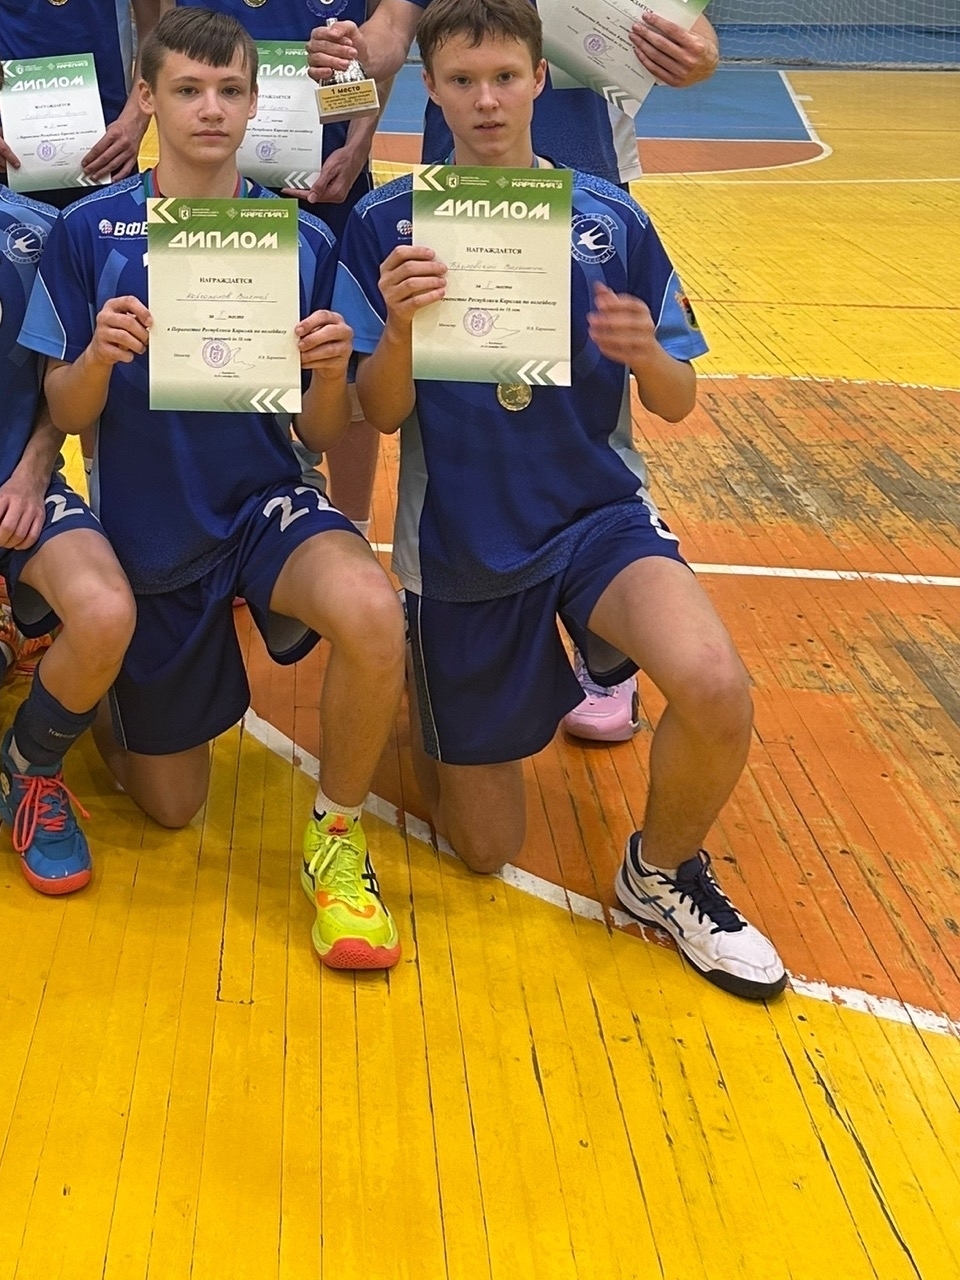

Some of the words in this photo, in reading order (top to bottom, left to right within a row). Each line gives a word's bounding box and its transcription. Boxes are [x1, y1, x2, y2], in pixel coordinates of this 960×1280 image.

[259, 63, 309, 77] ПЛОМ
[10, 75, 84, 92] ДИПЛОМ
[337, 85, 361, 94] место
[512, 181, 556, 189] КАРЕЛИЯ
[434, 199, 550, 220] ДИПЛОМ
[168, 231, 278, 249] ДИПЛОМ
[466, 247, 522, 255] НАГРАЖДАЕТСЯ
